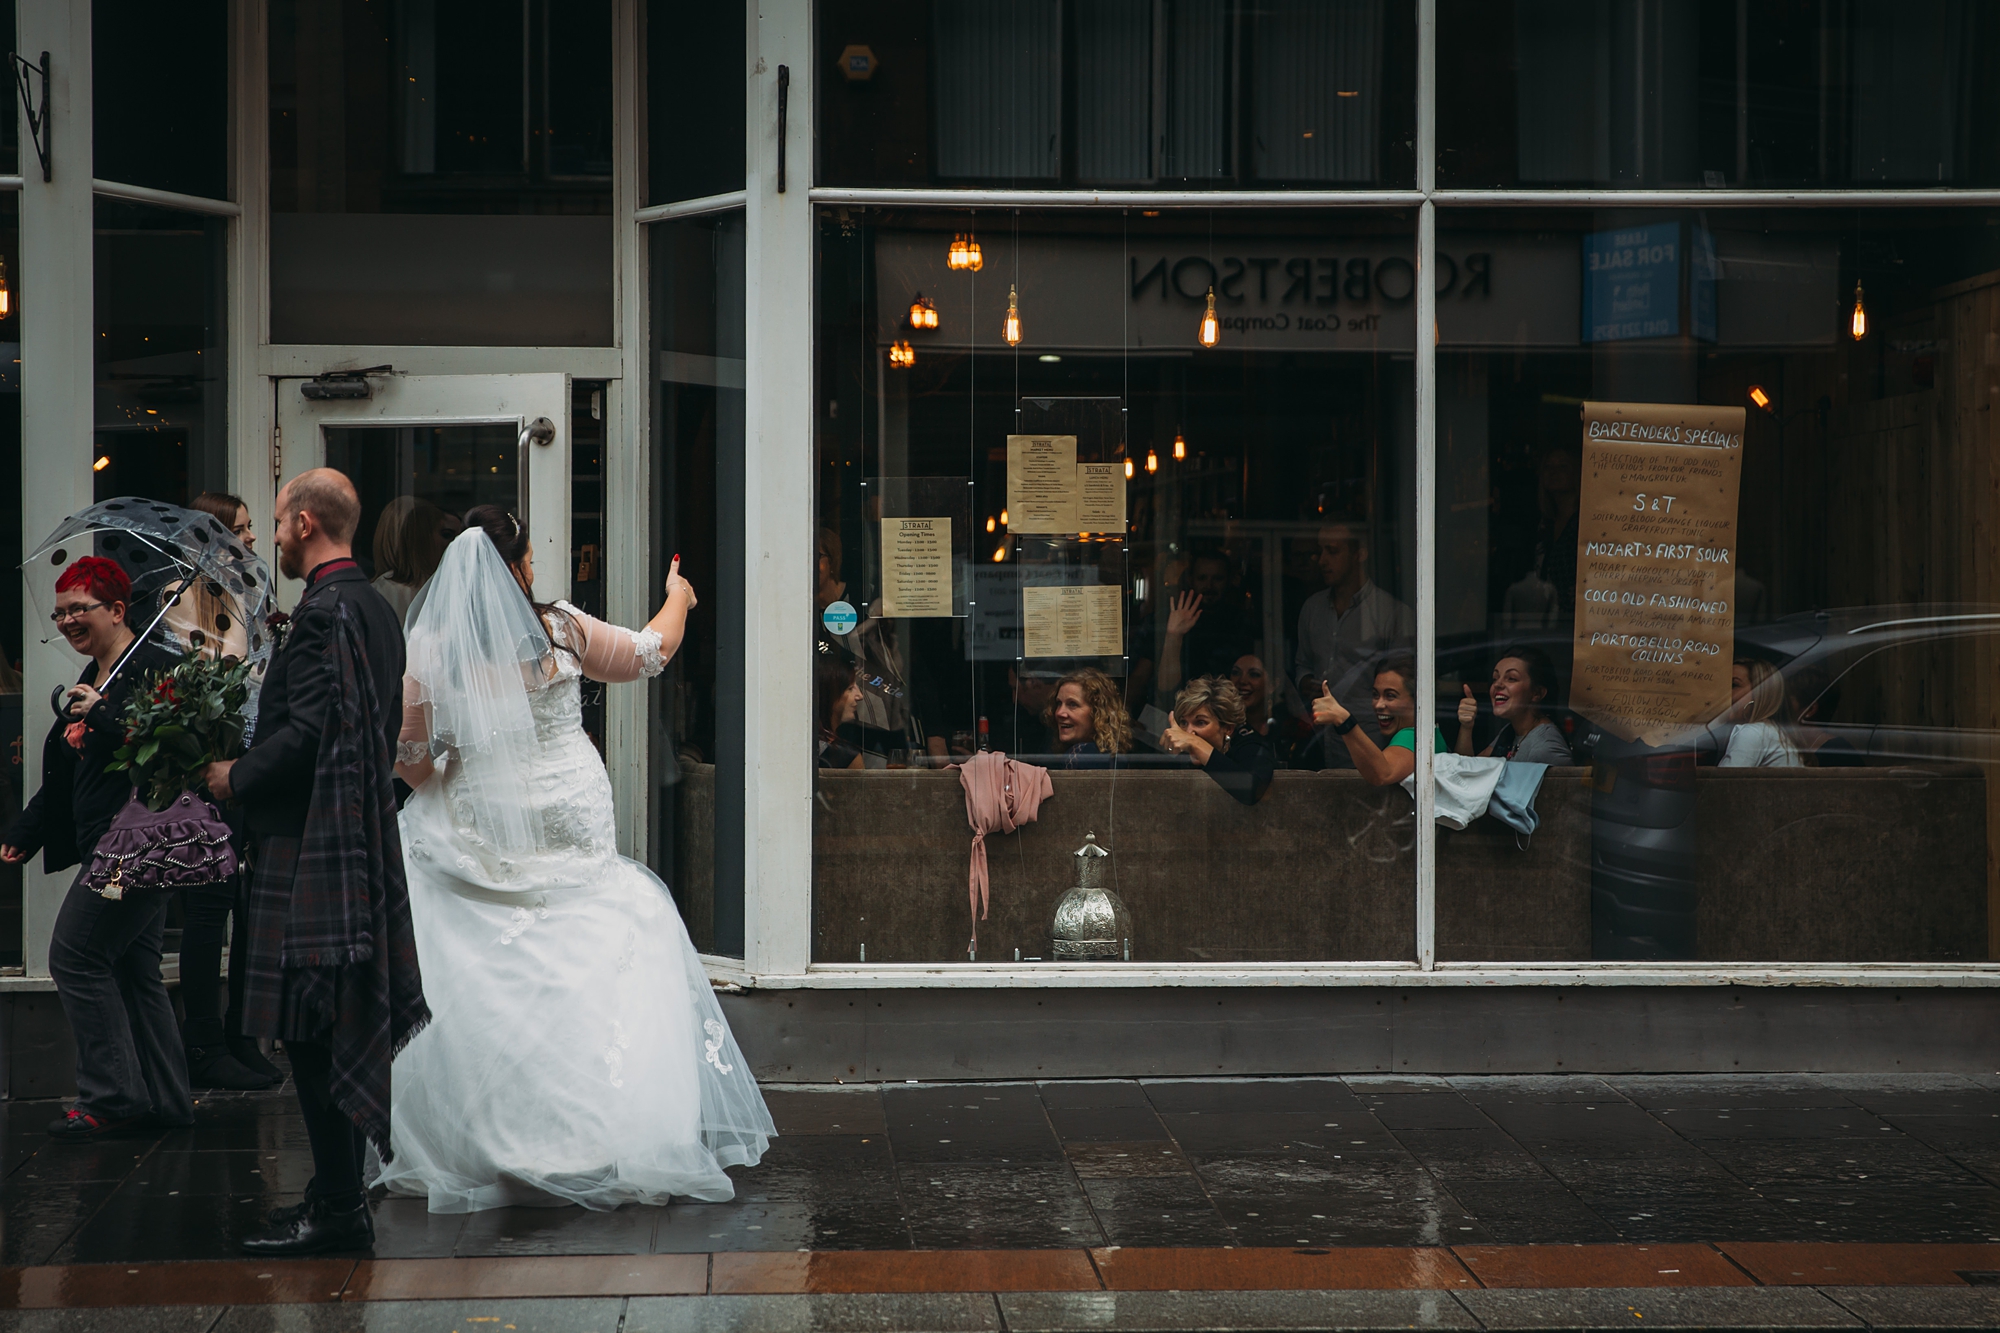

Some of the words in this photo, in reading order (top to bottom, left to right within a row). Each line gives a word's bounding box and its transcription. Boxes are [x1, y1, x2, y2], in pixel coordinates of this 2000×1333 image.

[1588, 420, 1681, 443] BARTENDERS
[1683, 428, 1740, 449] SPECIALS
[1589, 452, 1597, 461] A
[1600, 453, 1646, 464] SELECTION
[1649, 456, 1660, 464] OF
[1664, 455, 1678, 465] THE
[1683, 458, 1699, 466] ODD
[1701, 458, 1720, 468] AND
[1592, 461, 1607, 470] THE
[1611, 462, 1644, 471] CURIOUS
[1648, 464, 1669, 473] FROM
[1688, 467, 1723, 477] FRIENDS
[1632, 493, 1646, 512] S
[1651, 498, 1661, 511] &
[1662, 494, 1677, 513] T
[1629, 514, 1656, 523] BLOOD
[1657, 516, 1692, 526] ORANGE
[1695, 520, 1731, 530] LIQUEUR
[1621, 523, 1676, 535] GRAPEFRUIT
[1680, 528, 1706, 538] TONIC
[1585, 540, 1652, 557] MOZART'S
[1655, 543, 1695, 560] FIRST
[1695, 547, 1730, 564] SOUR
[1588, 561, 1628, 573] MOZART
[1630, 564, 1681, 578] CHOCOLATE
[1687, 568, 1715, 579] VODKA
[1593, 572, 1626, 581] CHERRY
[1628, 573, 1663, 584] HEERING
[1671, 578, 1705, 588] ORGEAT
[1584, 588, 1618, 604] COCO
[1621, 591, 1646, 606] OLD
[1649, 593, 1728, 614] FASHIONED
[1622, 608, 1643, 618] RUM
[1651, 611, 1684, 622] SALIZA
[1686, 614, 1732, 628] AMARETTO
[1628, 618, 1676, 630] PINEAPPLE
[1590, 632, 1682, 650] PORTOBELLO
[1682, 640, 1720, 656] ROAD
[1631, 649, 1684, 665] COLLINS
[1602, 675, 1630, 684] TOPPED
[1632, 676, 1653, 684] WITH
[1656, 678, 1676, 686] SODA
[1634, 666, 1653, 676] ROAD
[1656, 668, 1672, 677] GIN
[1680, 670, 1714, 682] APEROL
[869, 676, 904, 698] Bride
[1612, 692, 1651, 706] FOLLOW
[1655, 697, 1676, 708] US!
